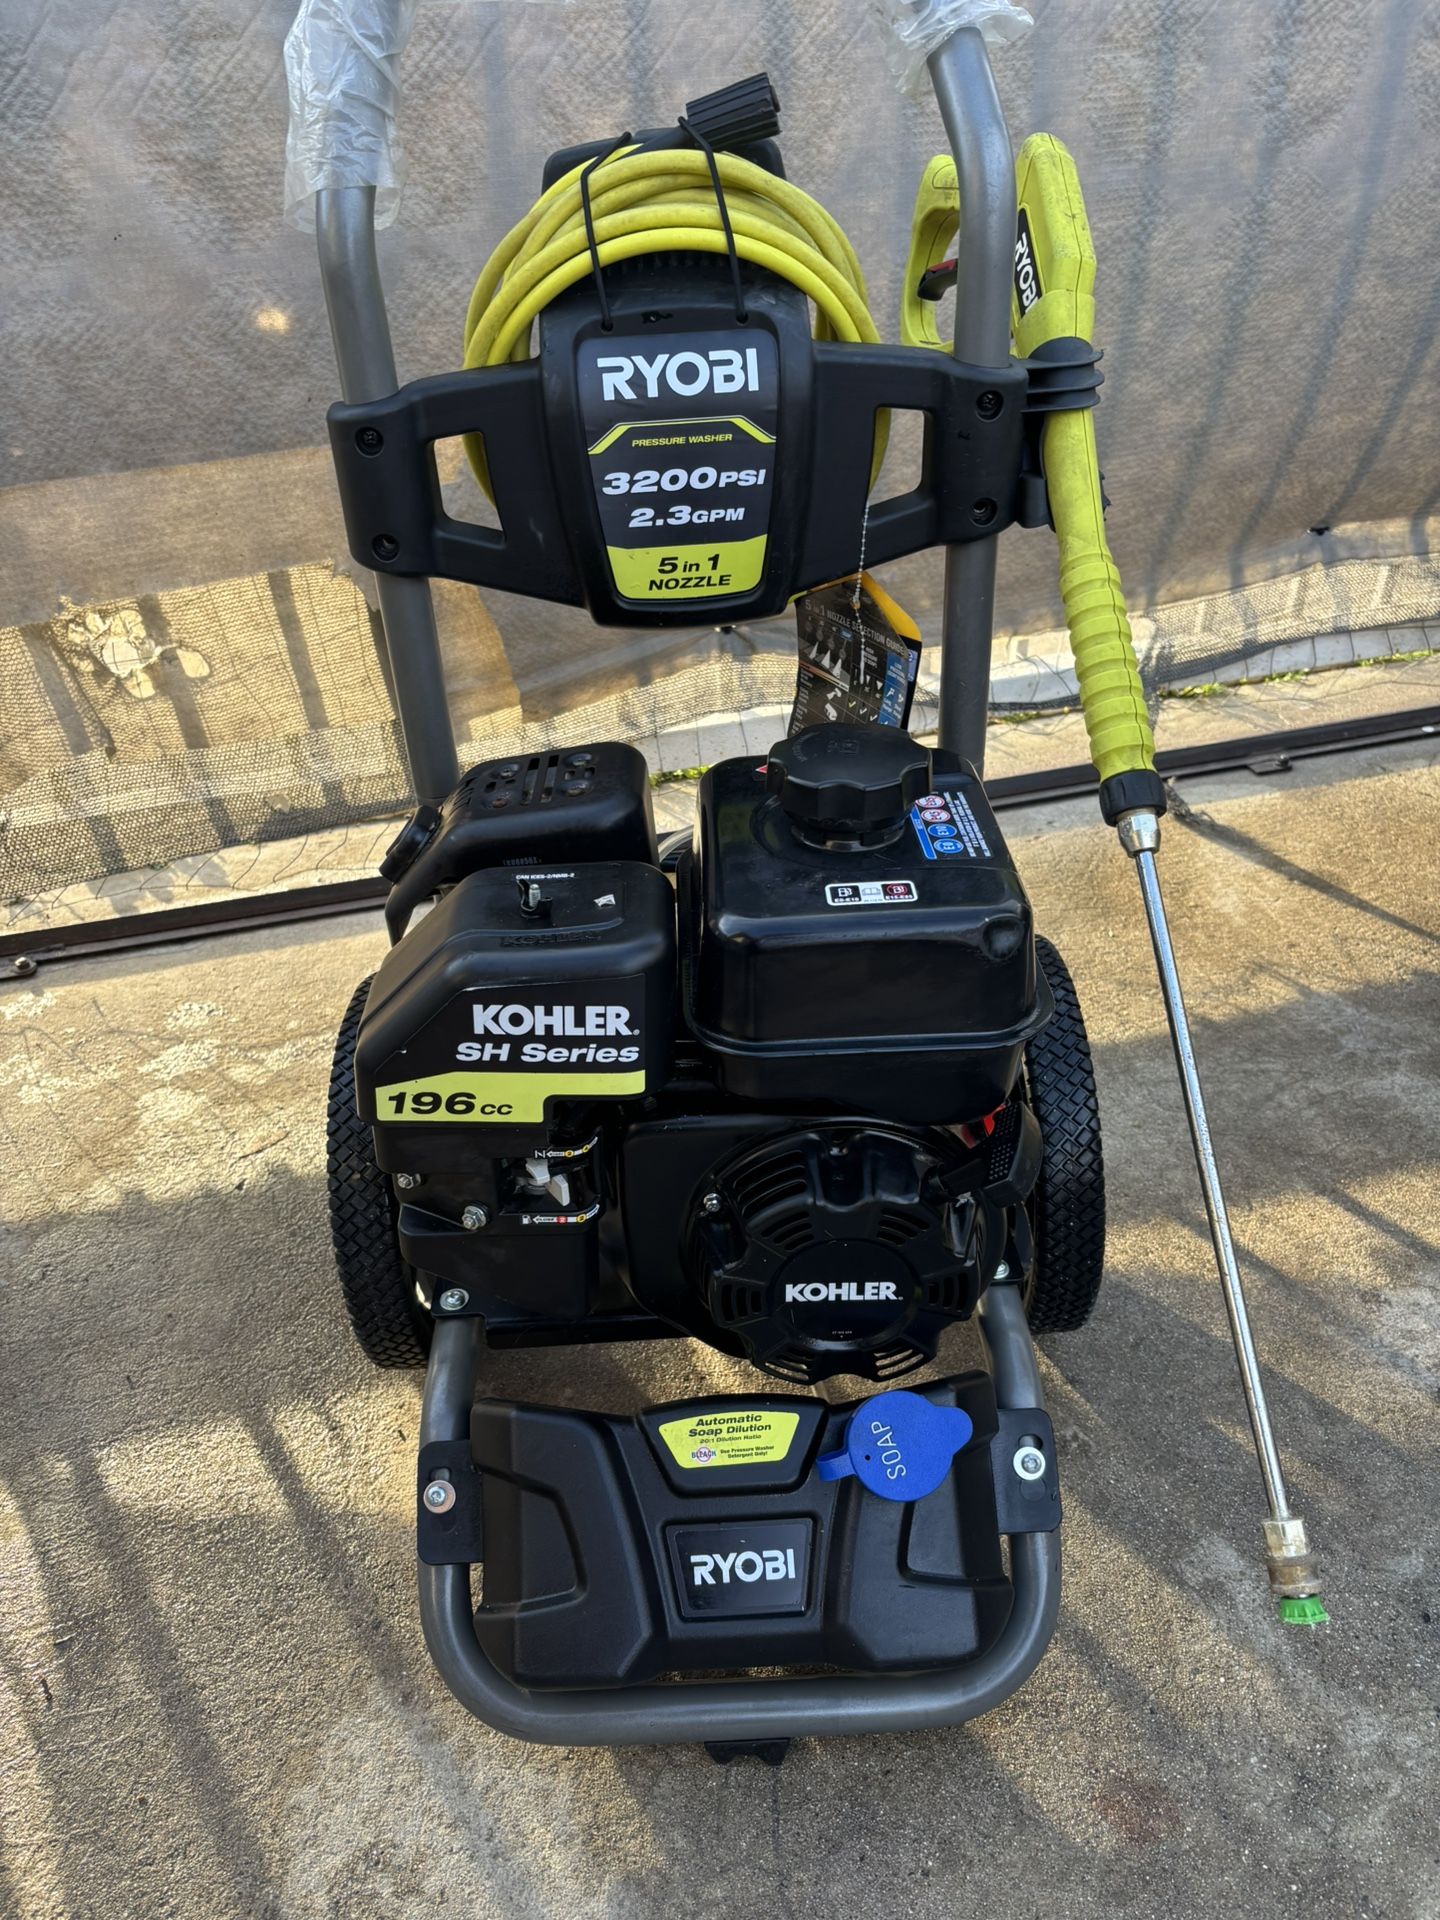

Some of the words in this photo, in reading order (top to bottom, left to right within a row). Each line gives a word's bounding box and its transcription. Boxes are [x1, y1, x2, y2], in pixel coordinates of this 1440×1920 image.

[1015, 231, 1039, 313] RYOBI
[597, 348, 759, 400] RYOBI
[631, 436, 686, 447] PRESSURE
[688, 433, 733, 444] WASHER
[602, 466, 766, 495] 3200PSI
[628, 505, 745, 528] 2.3GPM
[657, 557, 679, 575] 5
[682, 559, 700, 573] in
[707, 554, 720, 571] 1
[648, 574, 732, 591] NOZZLE
[827, 609, 851, 628] NOZZLE
[472, 1004, 633, 1036] KOHLER
[456, 1042, 512, 1062] SH
[520, 1043, 640, 1063] Series
[785, 1282, 898, 1302] KOHLER
[696, 1413, 762, 1426] Automatic
[688, 1428, 723, 1437] Soap
[727, 1424, 772, 1434] Dilution
[716, 1435, 742, 1443] Dilution
[691, 1449, 717, 1459] BLEACH
[871, 1421, 907, 1480] SOAP
[690, 1548, 796, 1586] RYOBI
